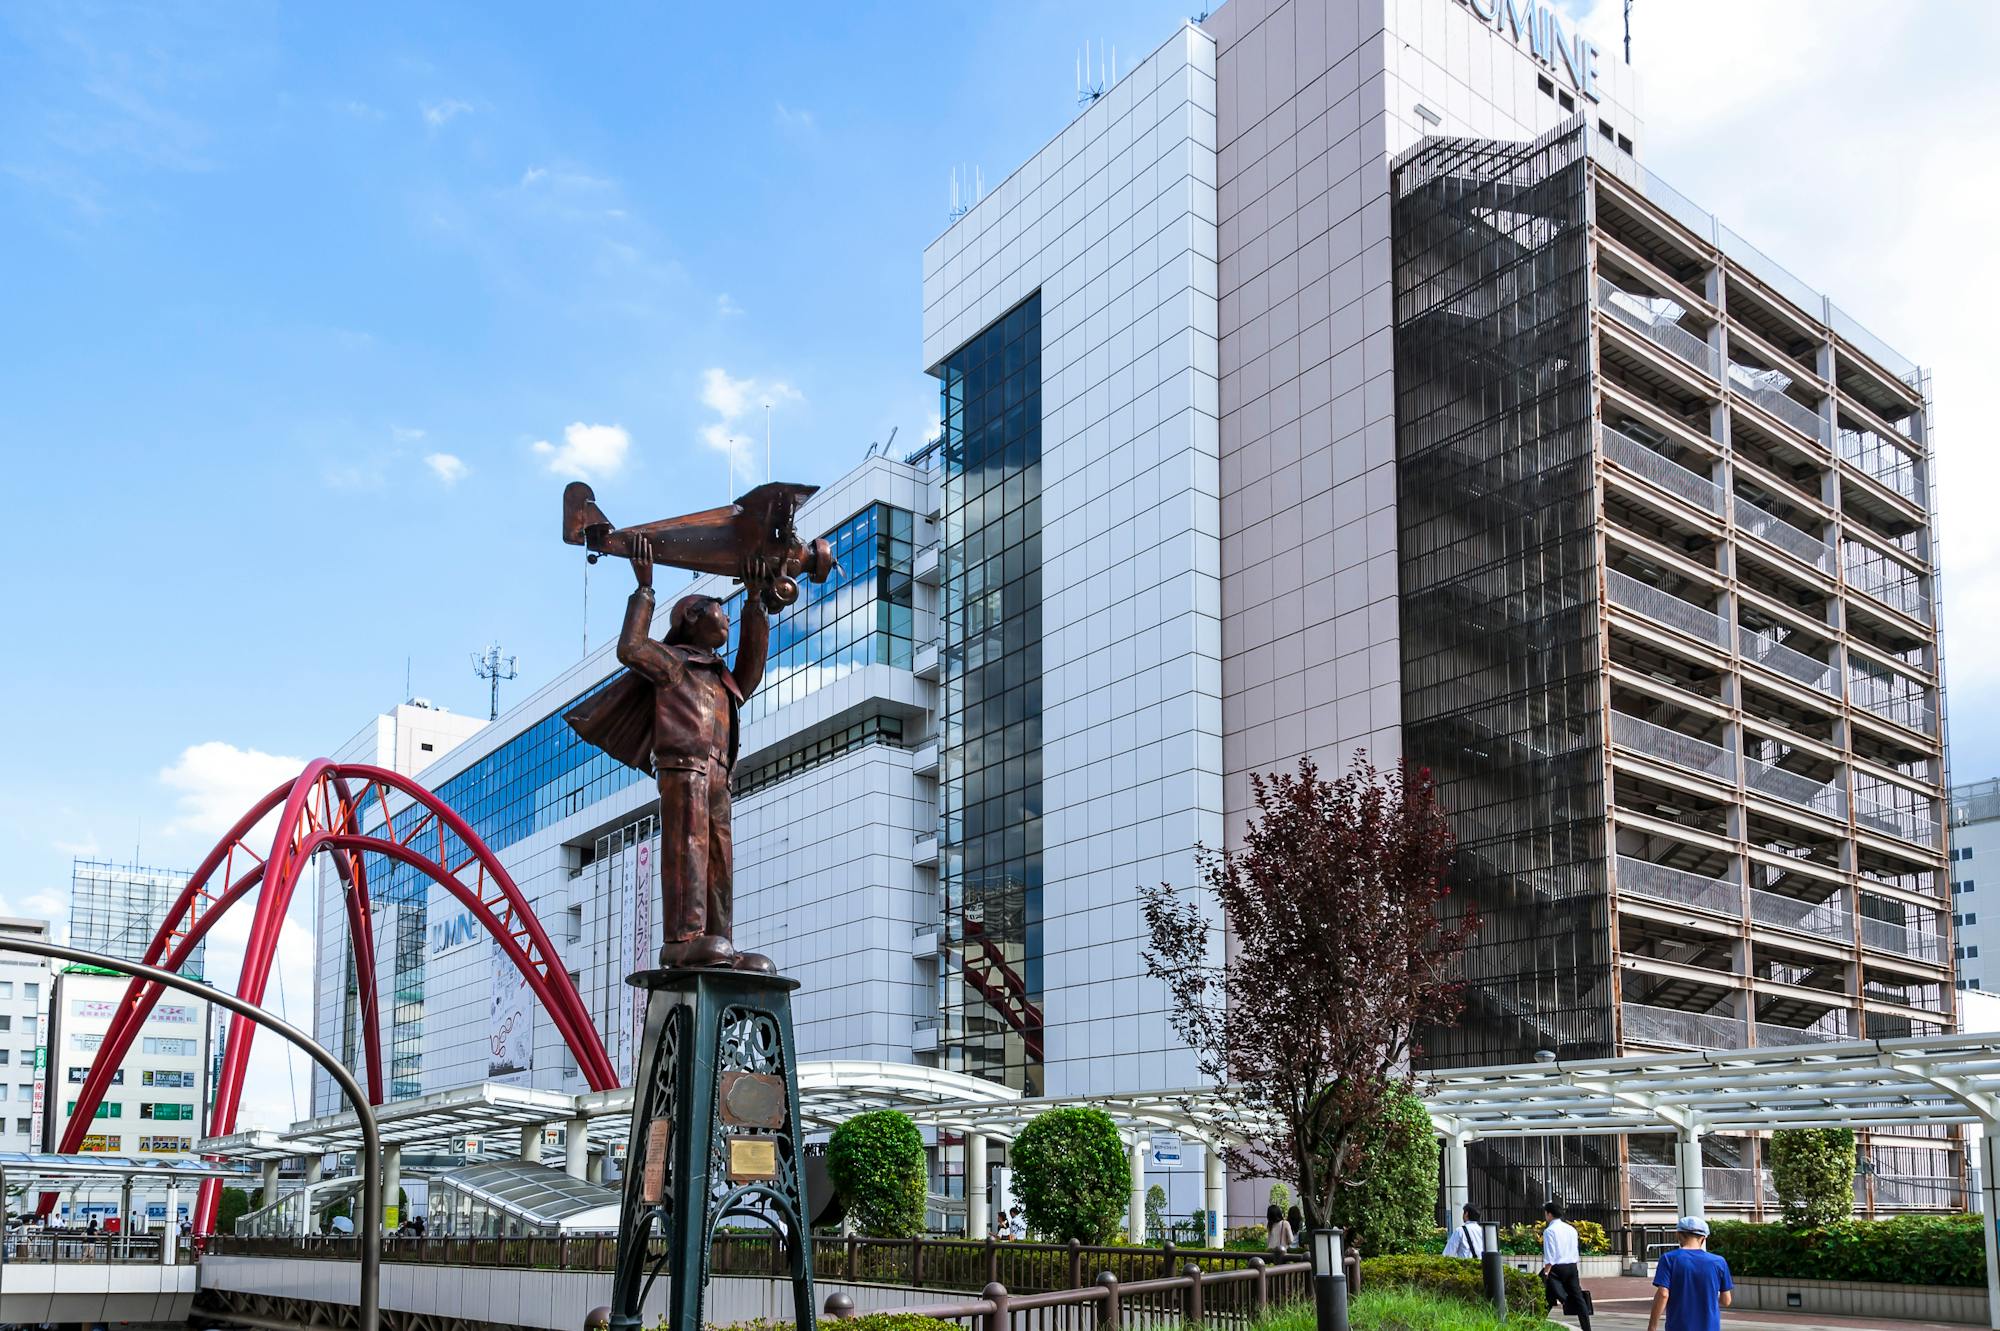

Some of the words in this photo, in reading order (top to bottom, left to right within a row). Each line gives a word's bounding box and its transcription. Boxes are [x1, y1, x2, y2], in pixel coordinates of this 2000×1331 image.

[637, 875, 646, 961] レストラン
